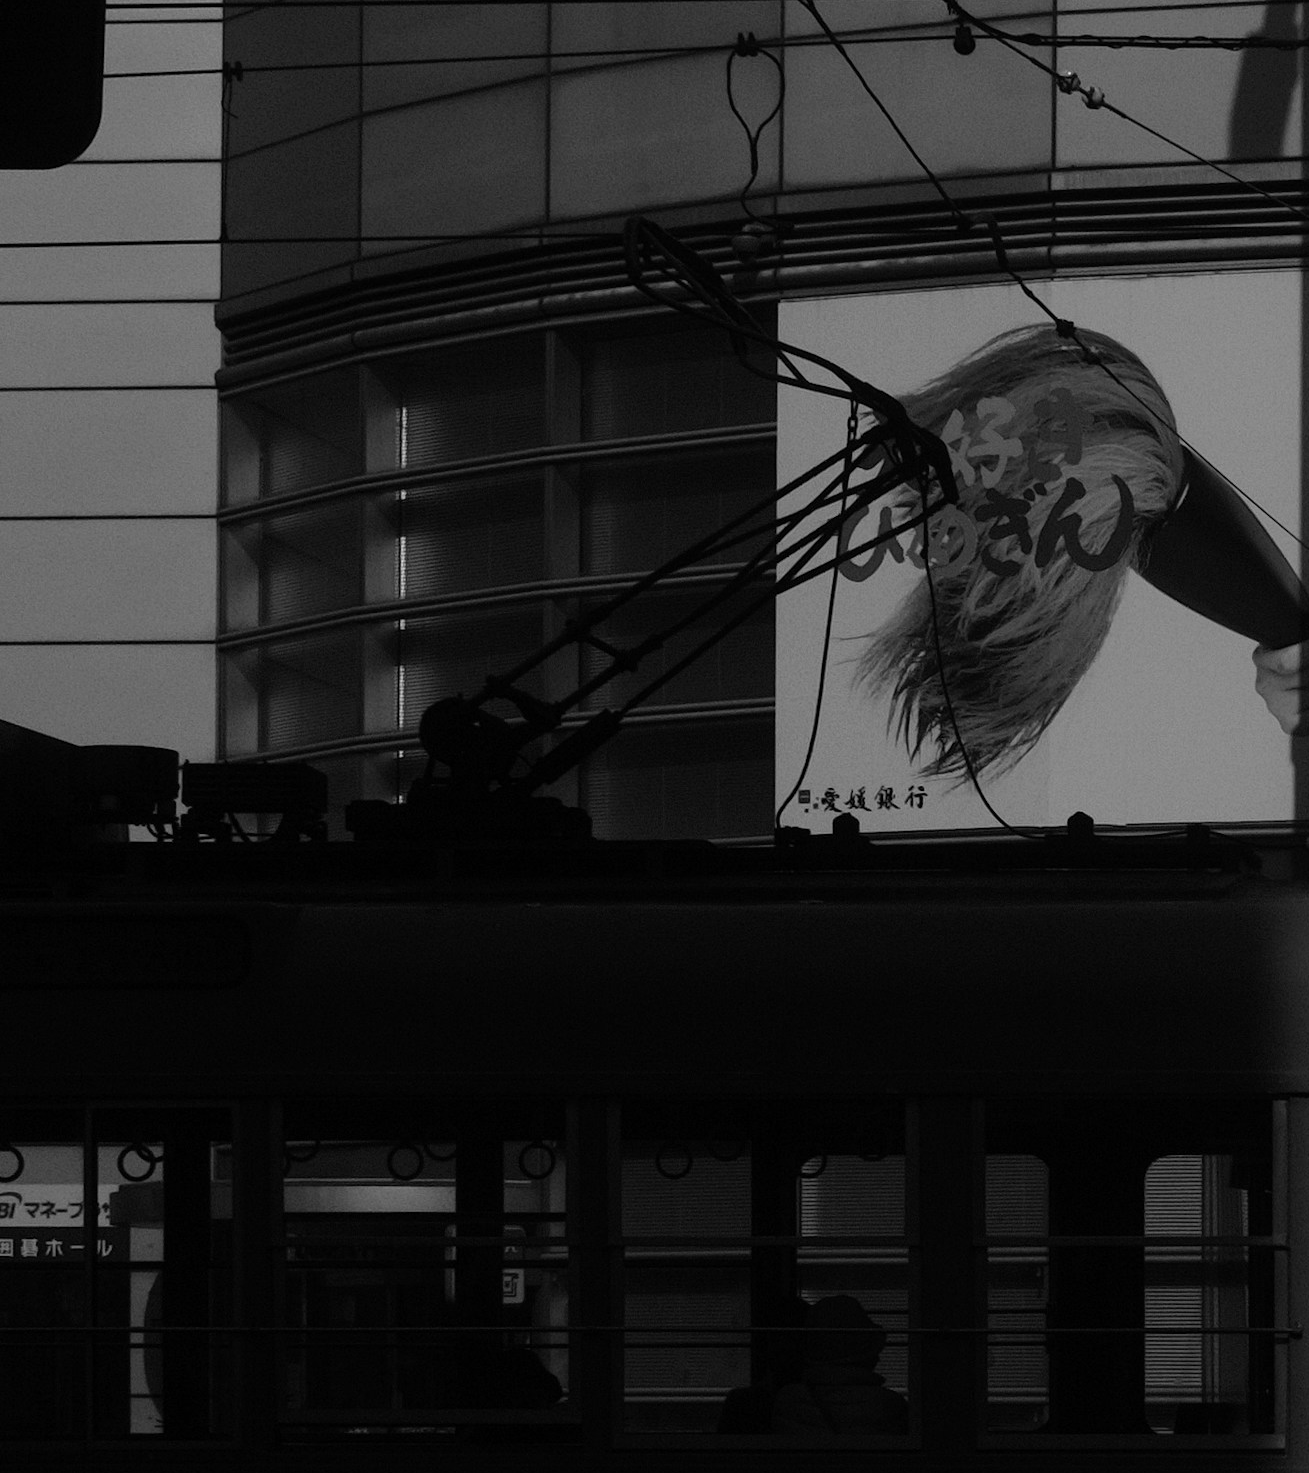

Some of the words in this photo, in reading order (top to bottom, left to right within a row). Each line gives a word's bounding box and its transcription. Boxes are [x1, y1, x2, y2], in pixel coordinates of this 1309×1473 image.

[837, 473, 1135, 583] ひめぎん
[820, 784, 929, 813] 愛媛銀行
